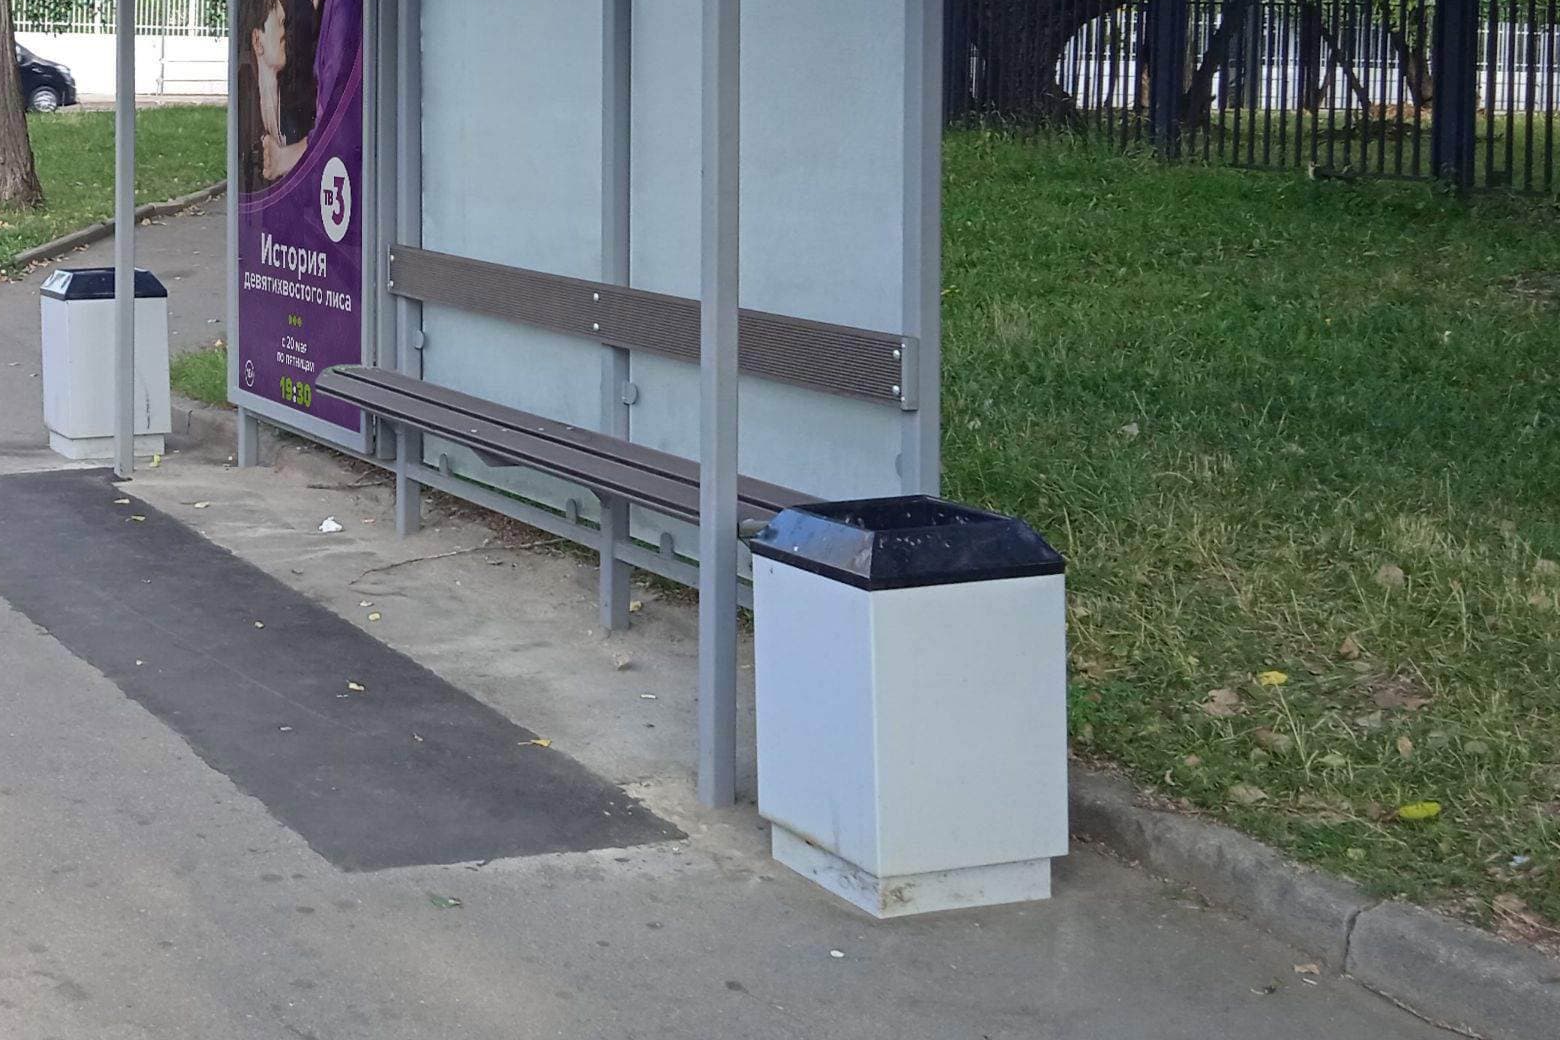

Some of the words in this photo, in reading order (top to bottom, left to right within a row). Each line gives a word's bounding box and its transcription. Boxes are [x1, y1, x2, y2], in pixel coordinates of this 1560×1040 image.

[261, 232, 327, 281] История
[243, 271, 324, 305] девятихвостого
[325, 290, 352, 312] лиса
[276, 351, 285, 364] по
[286, 335, 295, 350] 20
[280, 375, 312, 408] 19:30
